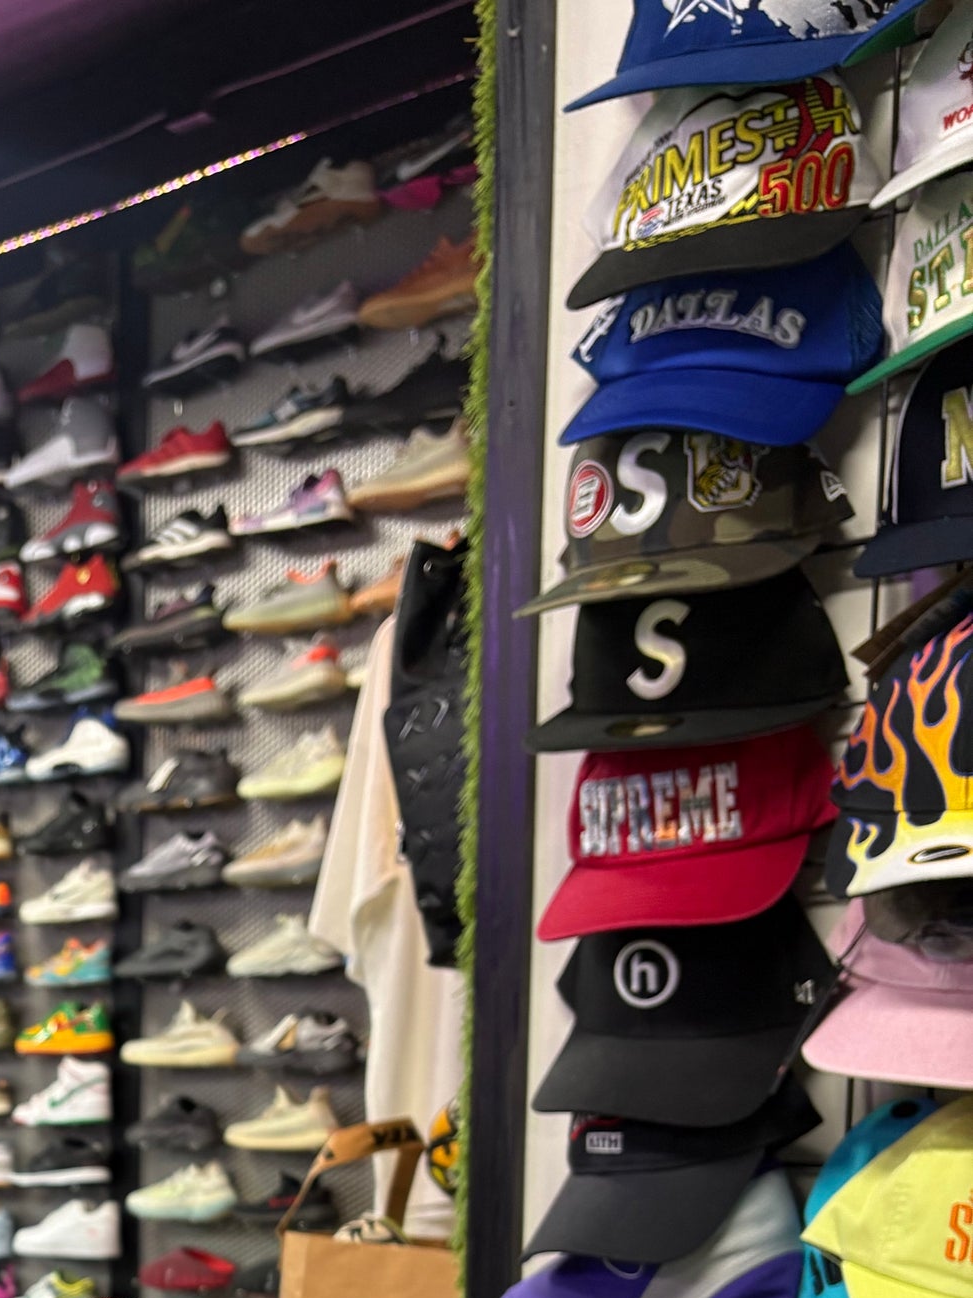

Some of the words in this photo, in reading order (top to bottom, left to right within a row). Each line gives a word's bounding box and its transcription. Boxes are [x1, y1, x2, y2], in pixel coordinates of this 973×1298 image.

[663, 177, 722, 222] TEXAS
[758, 141, 855, 217] 500
[629, 288, 806, 349] DALLAS
[609, 432, 671, 536] S
[626, 599, 691, 700] S
